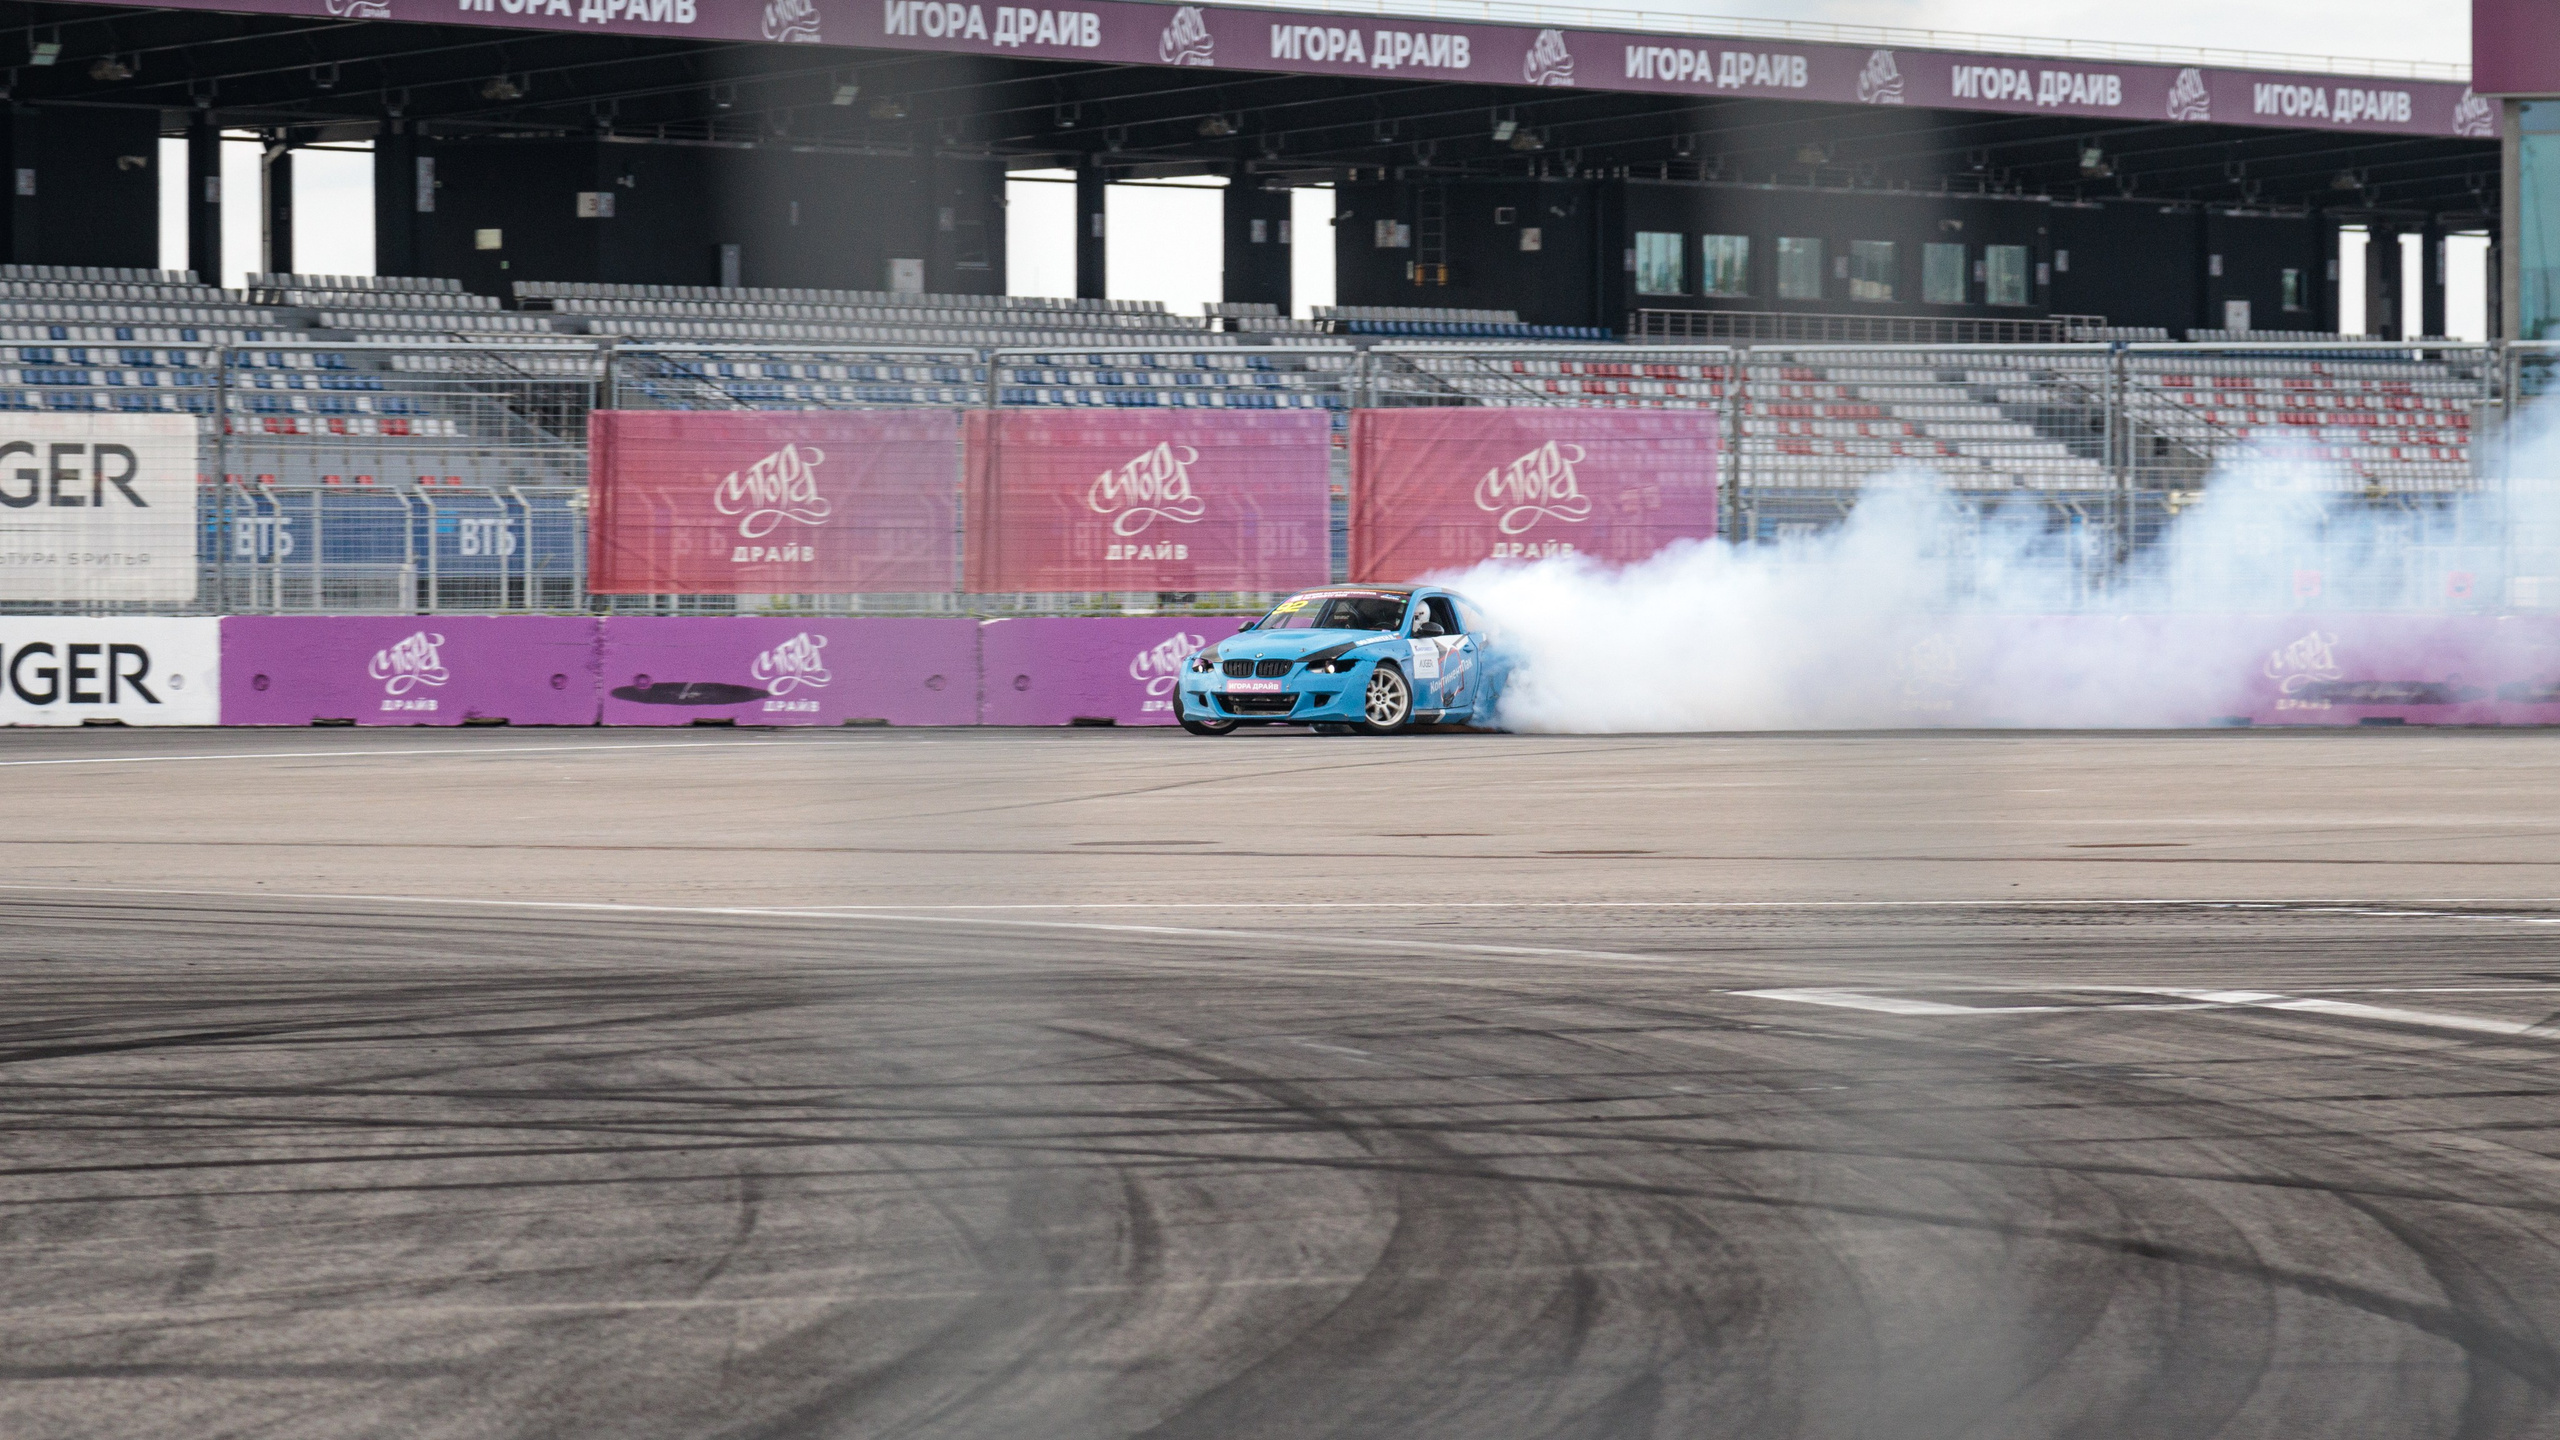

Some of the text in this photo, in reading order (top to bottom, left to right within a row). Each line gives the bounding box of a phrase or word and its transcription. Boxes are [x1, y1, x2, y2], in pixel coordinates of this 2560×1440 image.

[884, 0, 989, 40] ИГОРА
[1271, 24, 1366, 63] ИГОРА
[1625, 45, 1714, 83] ИГОРА
[1952, 65, 2033, 101] ИГОРА
[2254, 83, 2330, 118] ИГОРА
[0, 440, 151, 508] GER
[236, 517, 294, 556] ВТБ
[458, 518, 517, 556] ВТБ
[730, 542, 815, 562] ДРАЙВ
[1104, 540, 1189, 560] ДРАЙВ
[1490, 539, 1575, 559] ДРАЙВ
[1271, 600, 1309, 615] 92
[0, 641, 163, 706] GER
[1252, 682, 1279, 690] ДРАЙВ
